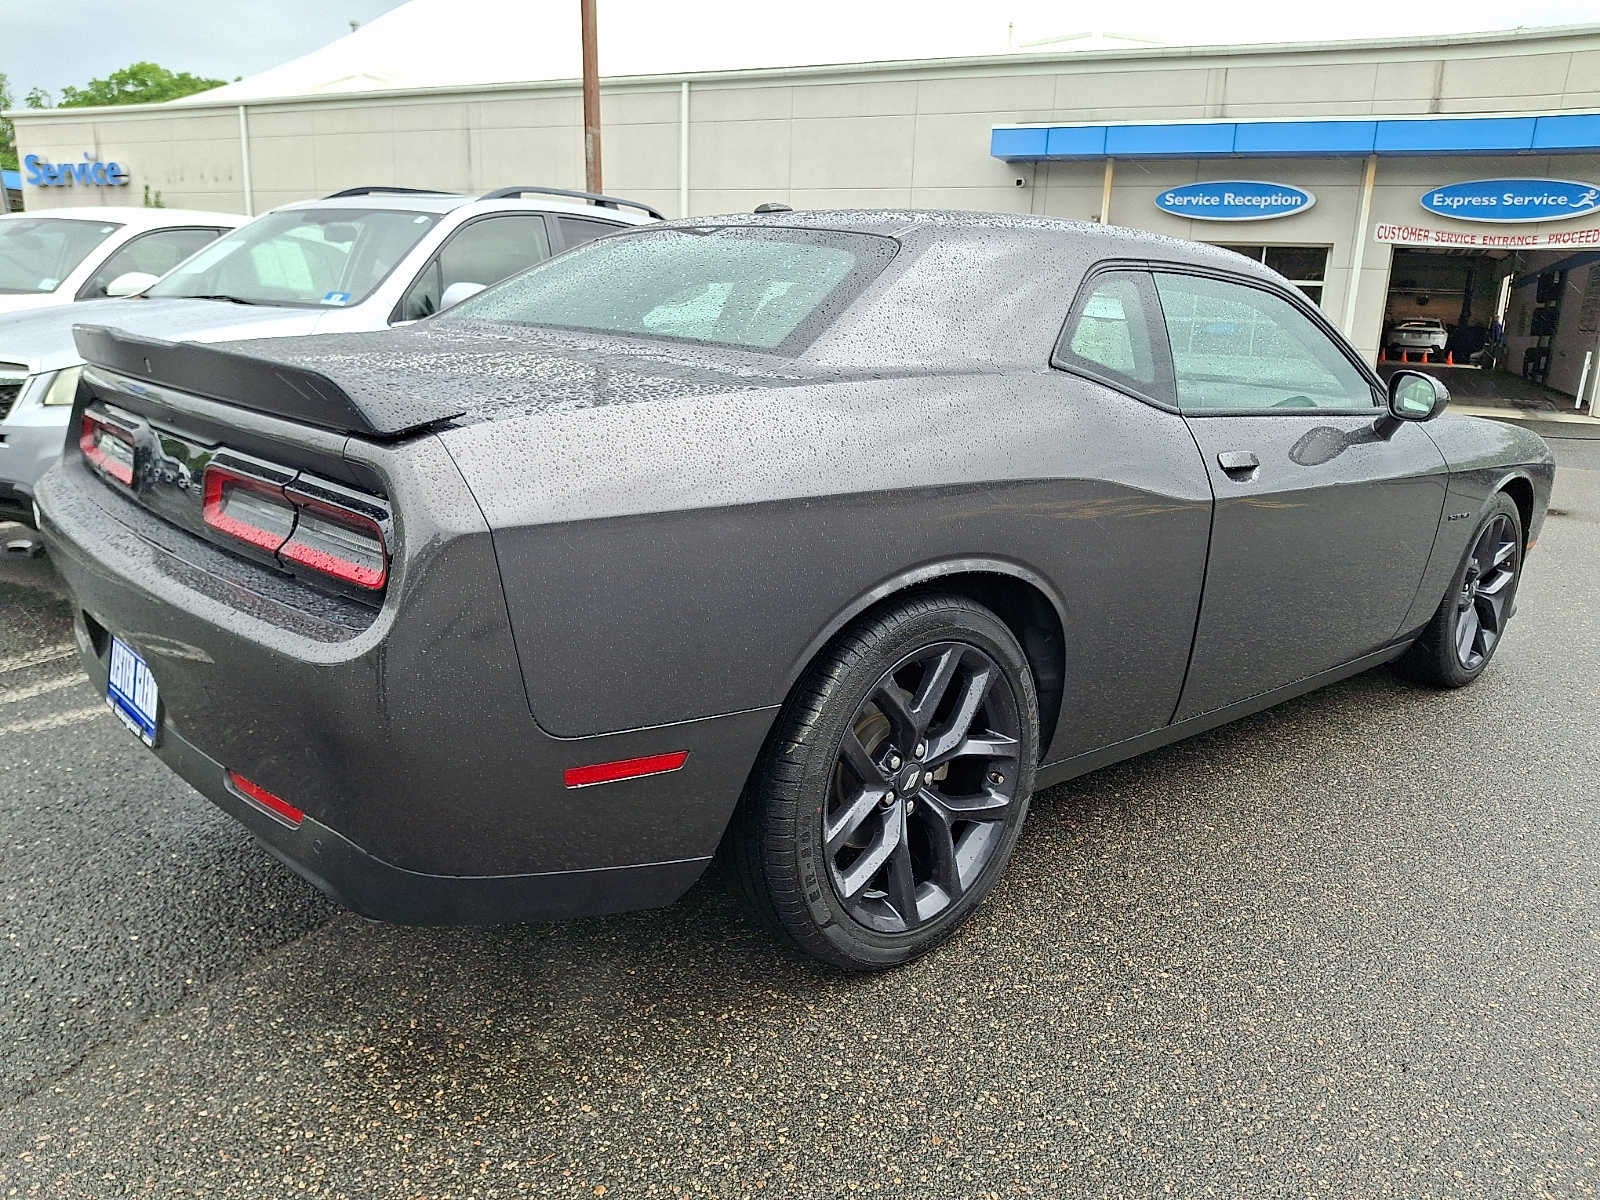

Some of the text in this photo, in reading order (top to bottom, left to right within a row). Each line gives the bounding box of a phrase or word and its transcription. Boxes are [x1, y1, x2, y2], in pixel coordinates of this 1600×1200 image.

[24, 152, 123, 186] Service
[1165, 192, 1302, 208] Service Reception
[1432, 193, 1568, 209] Express Service
[1377, 225, 1600, 246] CUSTOMER SERVICE ENTRANCE PROCEED
